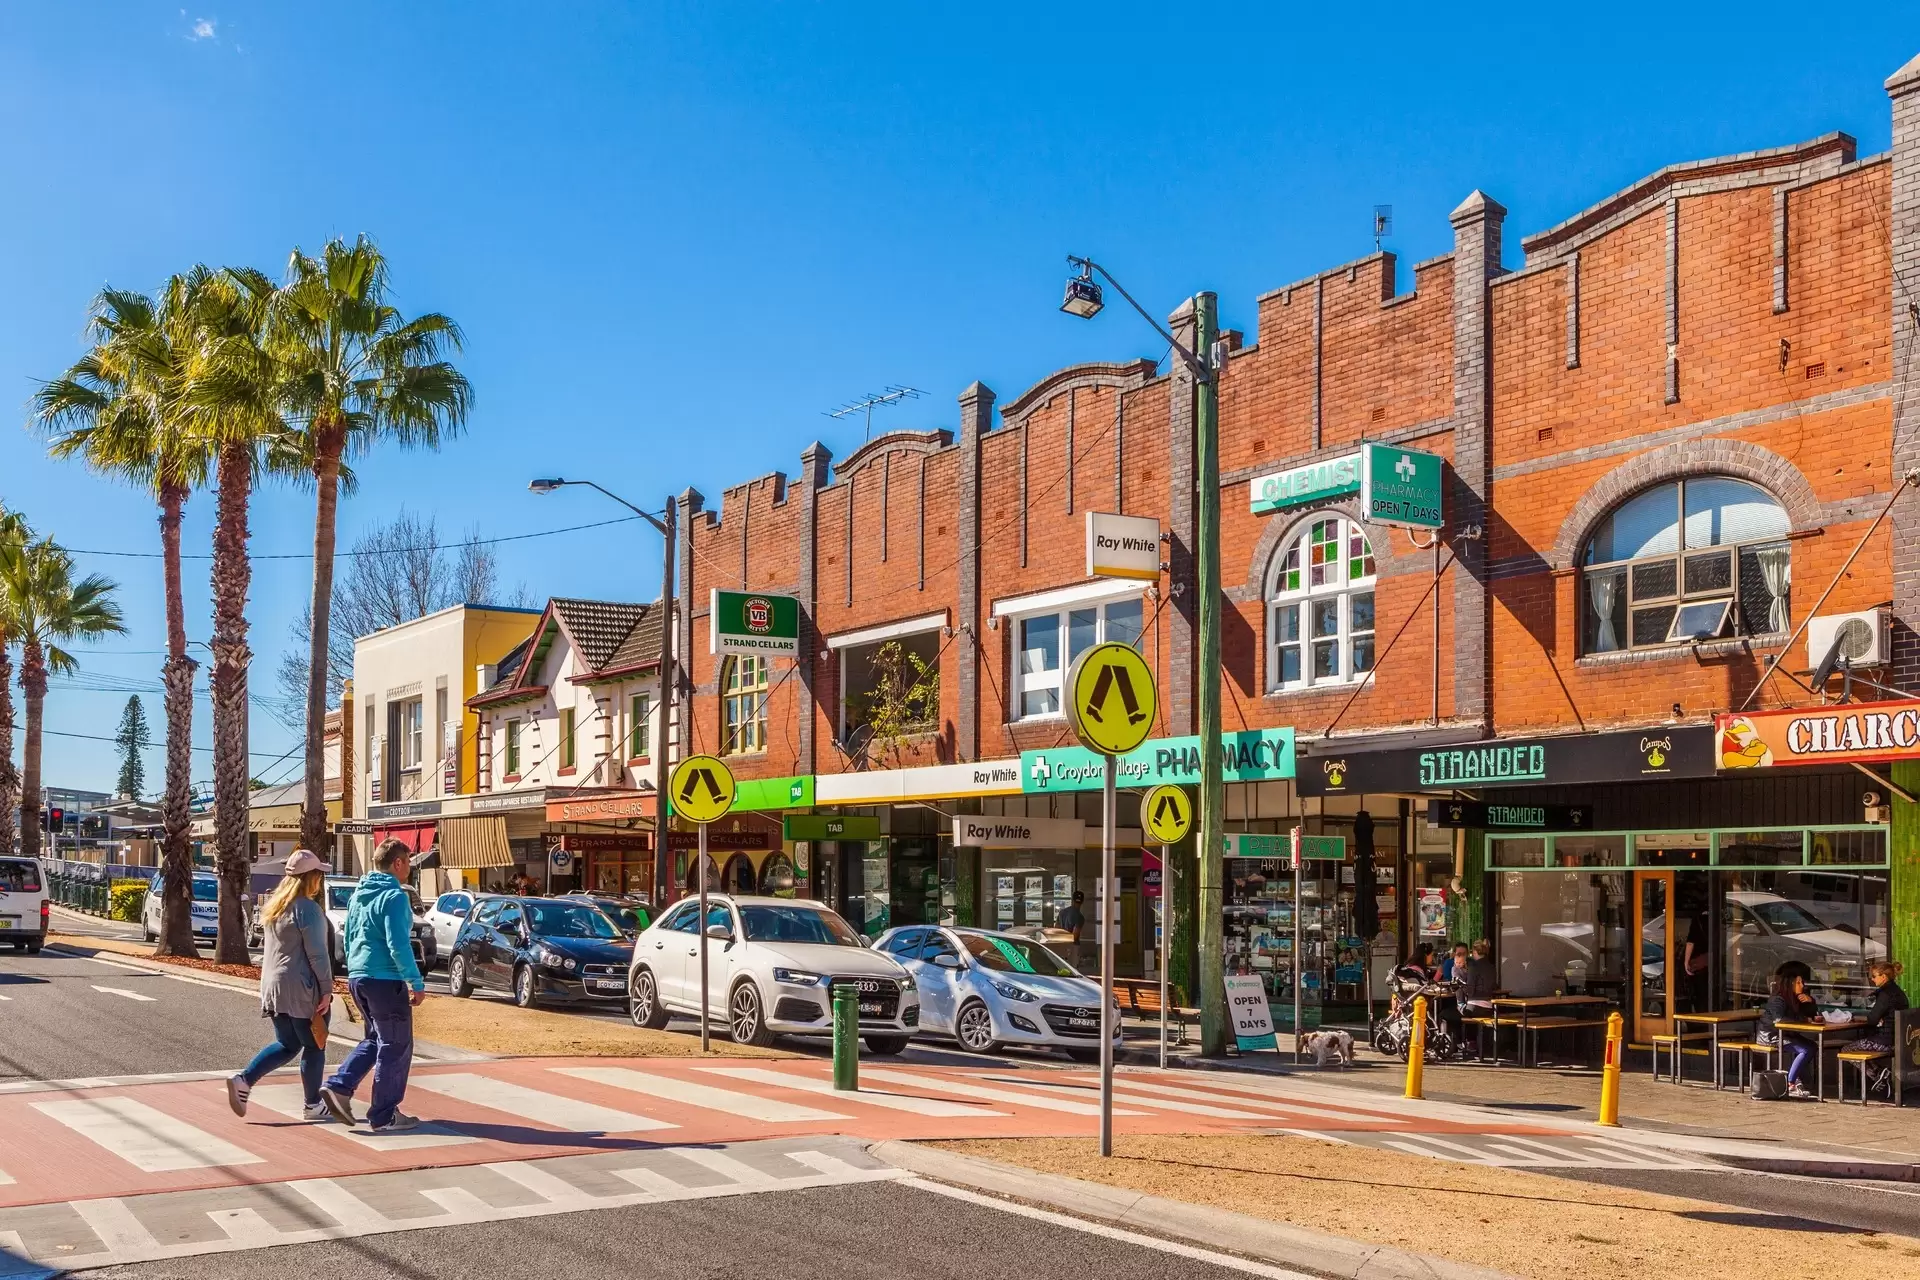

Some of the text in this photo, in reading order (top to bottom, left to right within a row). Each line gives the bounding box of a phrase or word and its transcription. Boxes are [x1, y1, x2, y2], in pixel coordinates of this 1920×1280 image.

[1262, 457, 1361, 501] CHEMIST
[1372, 480, 1440, 503] PHARMACY
[1372, 499, 1439, 521] OPEN 7 DAYS
[1097, 535, 1156, 552] Ray White
[746, 599, 771, 609] VICTORIA
[751, 610, 766, 620] VB
[748, 624, 770, 632] BITTER
[723, 638, 794, 649] STRAND CELLARS
[1055, 739, 1286, 784] Croydon illage PHAMACY
[1420, 745, 1545, 785] STRANDED
[973, 767, 1017, 785] Ray White
[791, 787, 802, 797] TAB
[520, 794, 545, 804] RESTAURANT
[563, 801, 643, 819] STRAND CELLARS
[1488, 806, 1545, 825] STRANDED
[249, 818, 268, 830] afe
[341, 825, 373, 833] ACADEM
[827, 823, 843, 833] TAB
[966, 823, 1030, 840] Ray White
[570, 838, 648, 848] STRAND CELL
[668, 834, 763, 845] TRAN CELLARS
[1249, 837, 1336, 857] PHARACY
[1236, 980, 1260, 988] pharmacy
[1234, 996, 1262, 1005] OPEN
[1247, 1008, 1253, 1017] 7
[1240, 1019, 1267, 1029] DAYS
